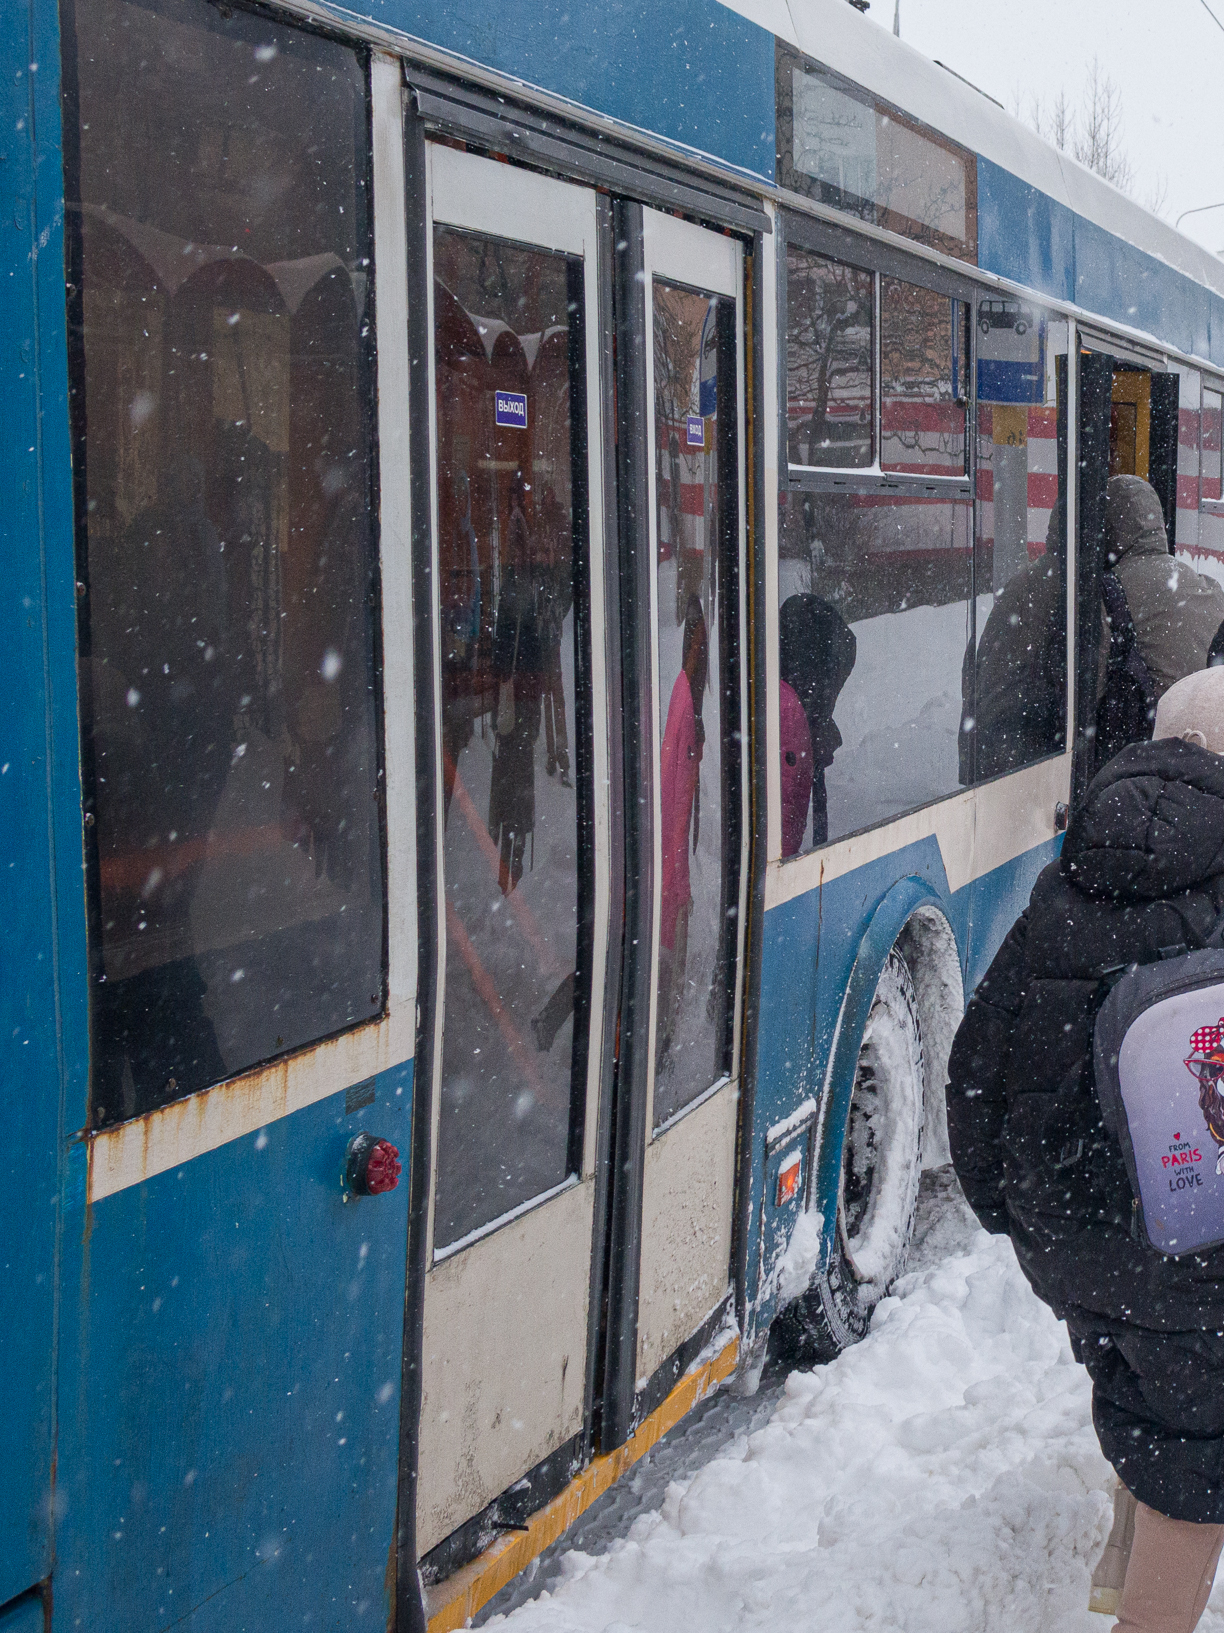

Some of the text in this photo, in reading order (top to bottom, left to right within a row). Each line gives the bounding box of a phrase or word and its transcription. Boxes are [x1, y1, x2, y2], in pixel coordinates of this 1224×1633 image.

[498, 399, 524, 417] ВЫХОД
[1168, 1142, 1191, 1152] FROM
[1161, 1148, 1202, 1169] PARIS
[1174, 1166, 1194, 1176] WITH
[1169, 1173, 1203, 1192] LOVE
